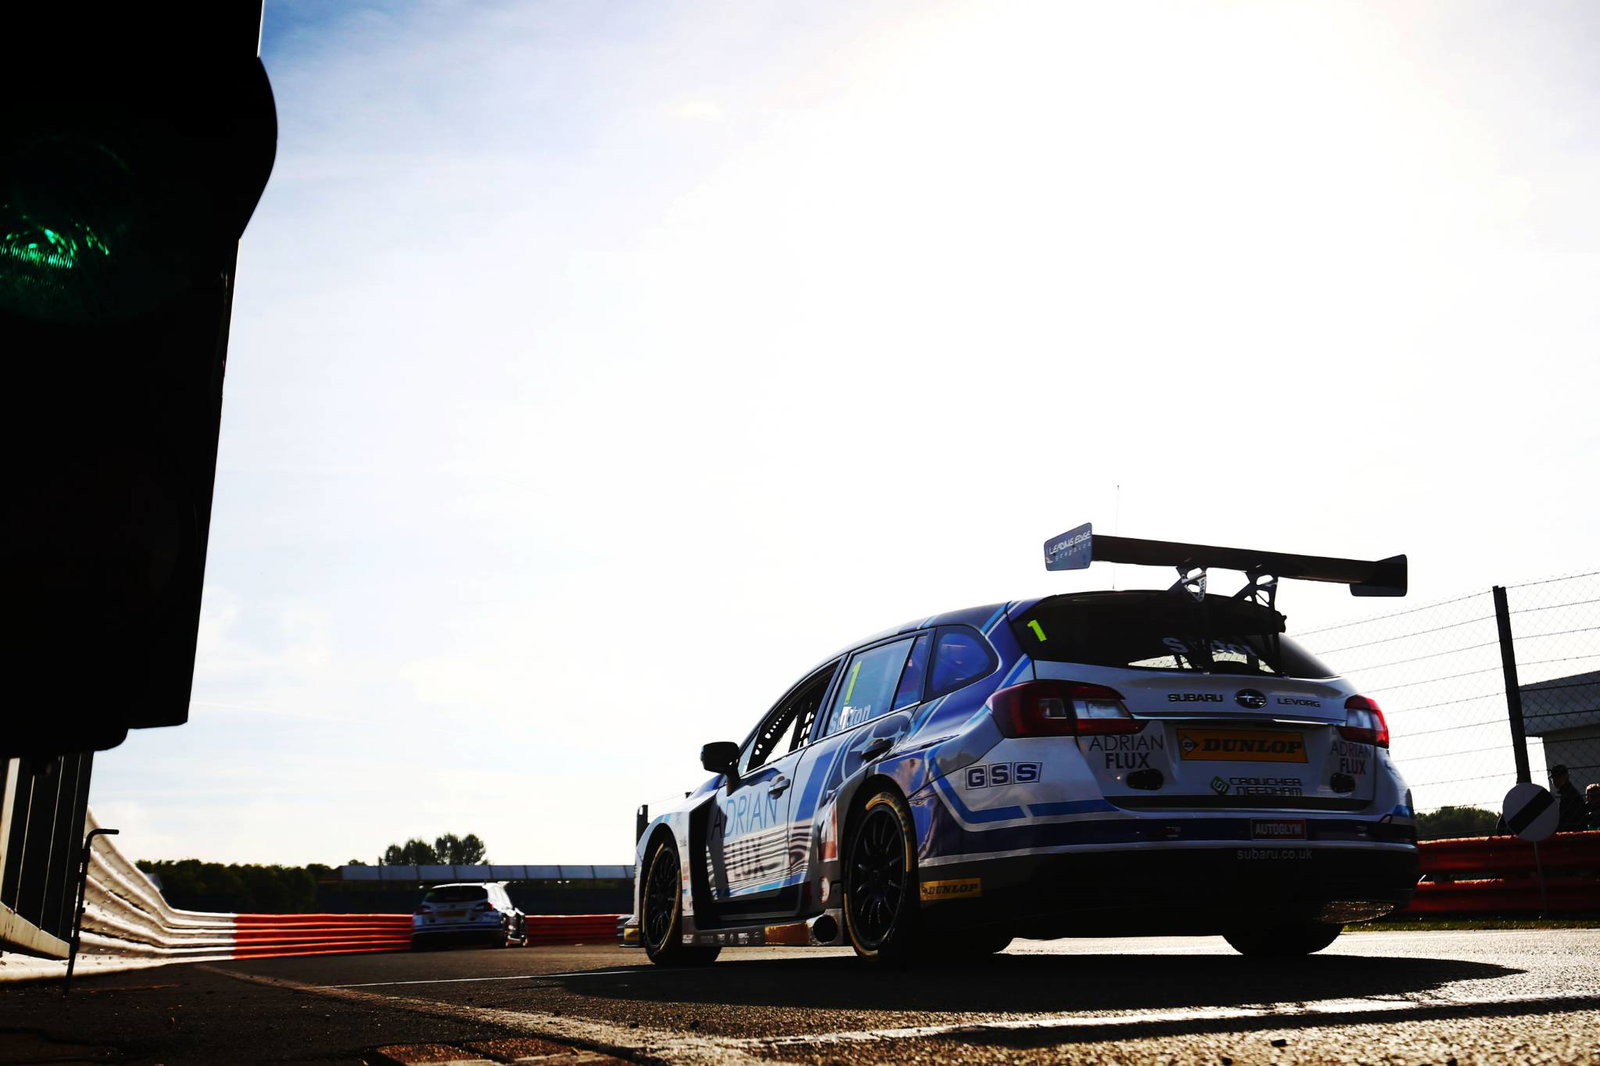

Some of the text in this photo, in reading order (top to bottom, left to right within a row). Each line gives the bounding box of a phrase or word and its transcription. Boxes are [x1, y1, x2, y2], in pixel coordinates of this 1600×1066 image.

[1074, 530, 1092, 545] EDGE
[1027, 619, 1047, 642] 1
[845, 660, 863, 704] 1
[1167, 693, 1224, 703] SUBARU
[1277, 698, 1321, 708] LEVORG
[1088, 734, 1164, 752] ADRIAN
[1201, 737, 1302, 754] DUNLOP
[1330, 741, 1371, 758] ADRIAN
[1105, 752, 1150, 769] FLUX
[1340, 758, 1367, 775] FLUX
[967, 763, 1037, 788] GSS
[1229, 777, 1302, 786] CROUCHER
[1236, 786, 1303, 796] NEEDHAM
[710, 789, 778, 840] ADRIAN
[1255, 823, 1303, 835] AUTOGLYM
[1236, 847, 1313, 860] subaru.co.uk
[927, 883, 979, 895] DUNLOP
